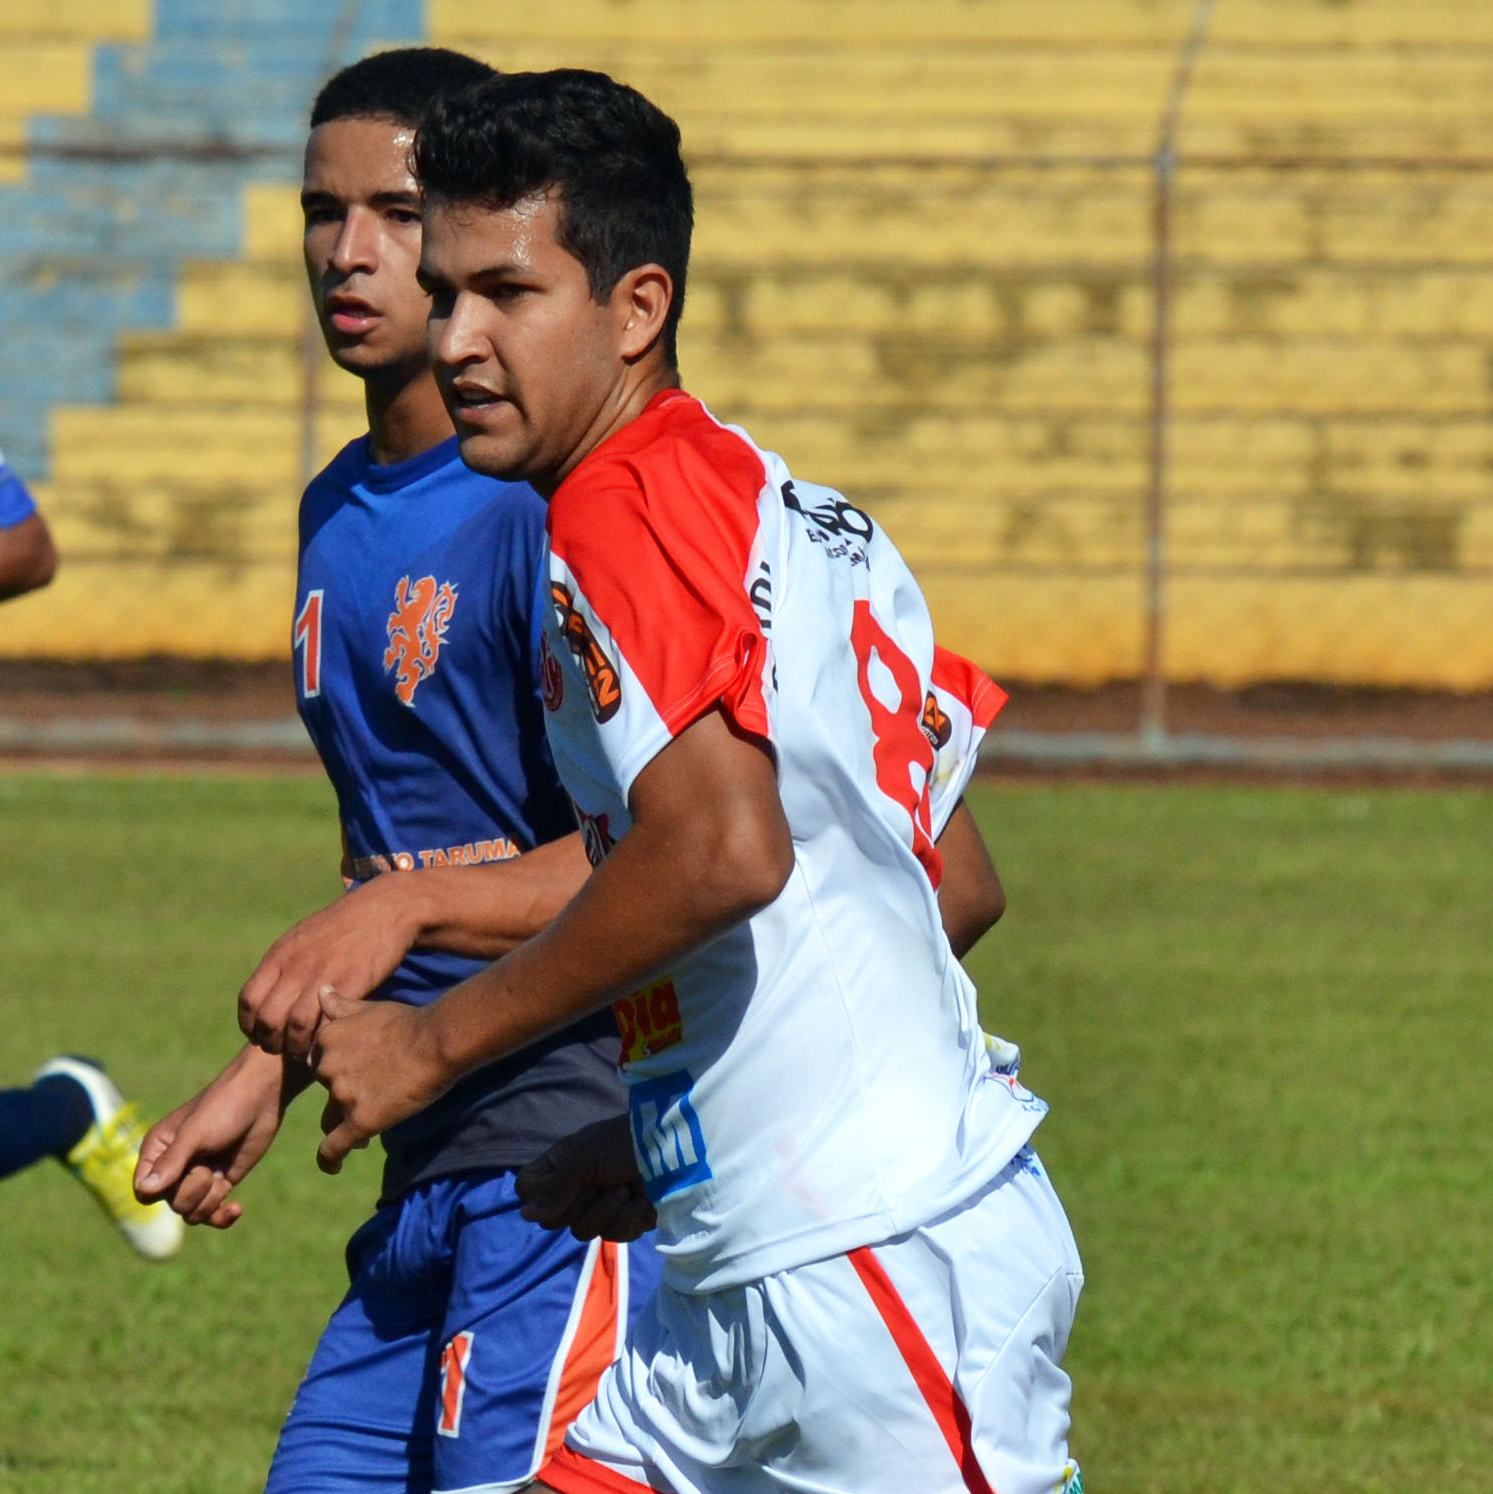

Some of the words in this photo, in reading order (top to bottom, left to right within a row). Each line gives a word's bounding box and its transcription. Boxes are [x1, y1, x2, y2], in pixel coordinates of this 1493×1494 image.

[294, 589, 324, 698] 1
[850, 599, 943, 890] 8
[437, 1330, 475, 1439] 1
